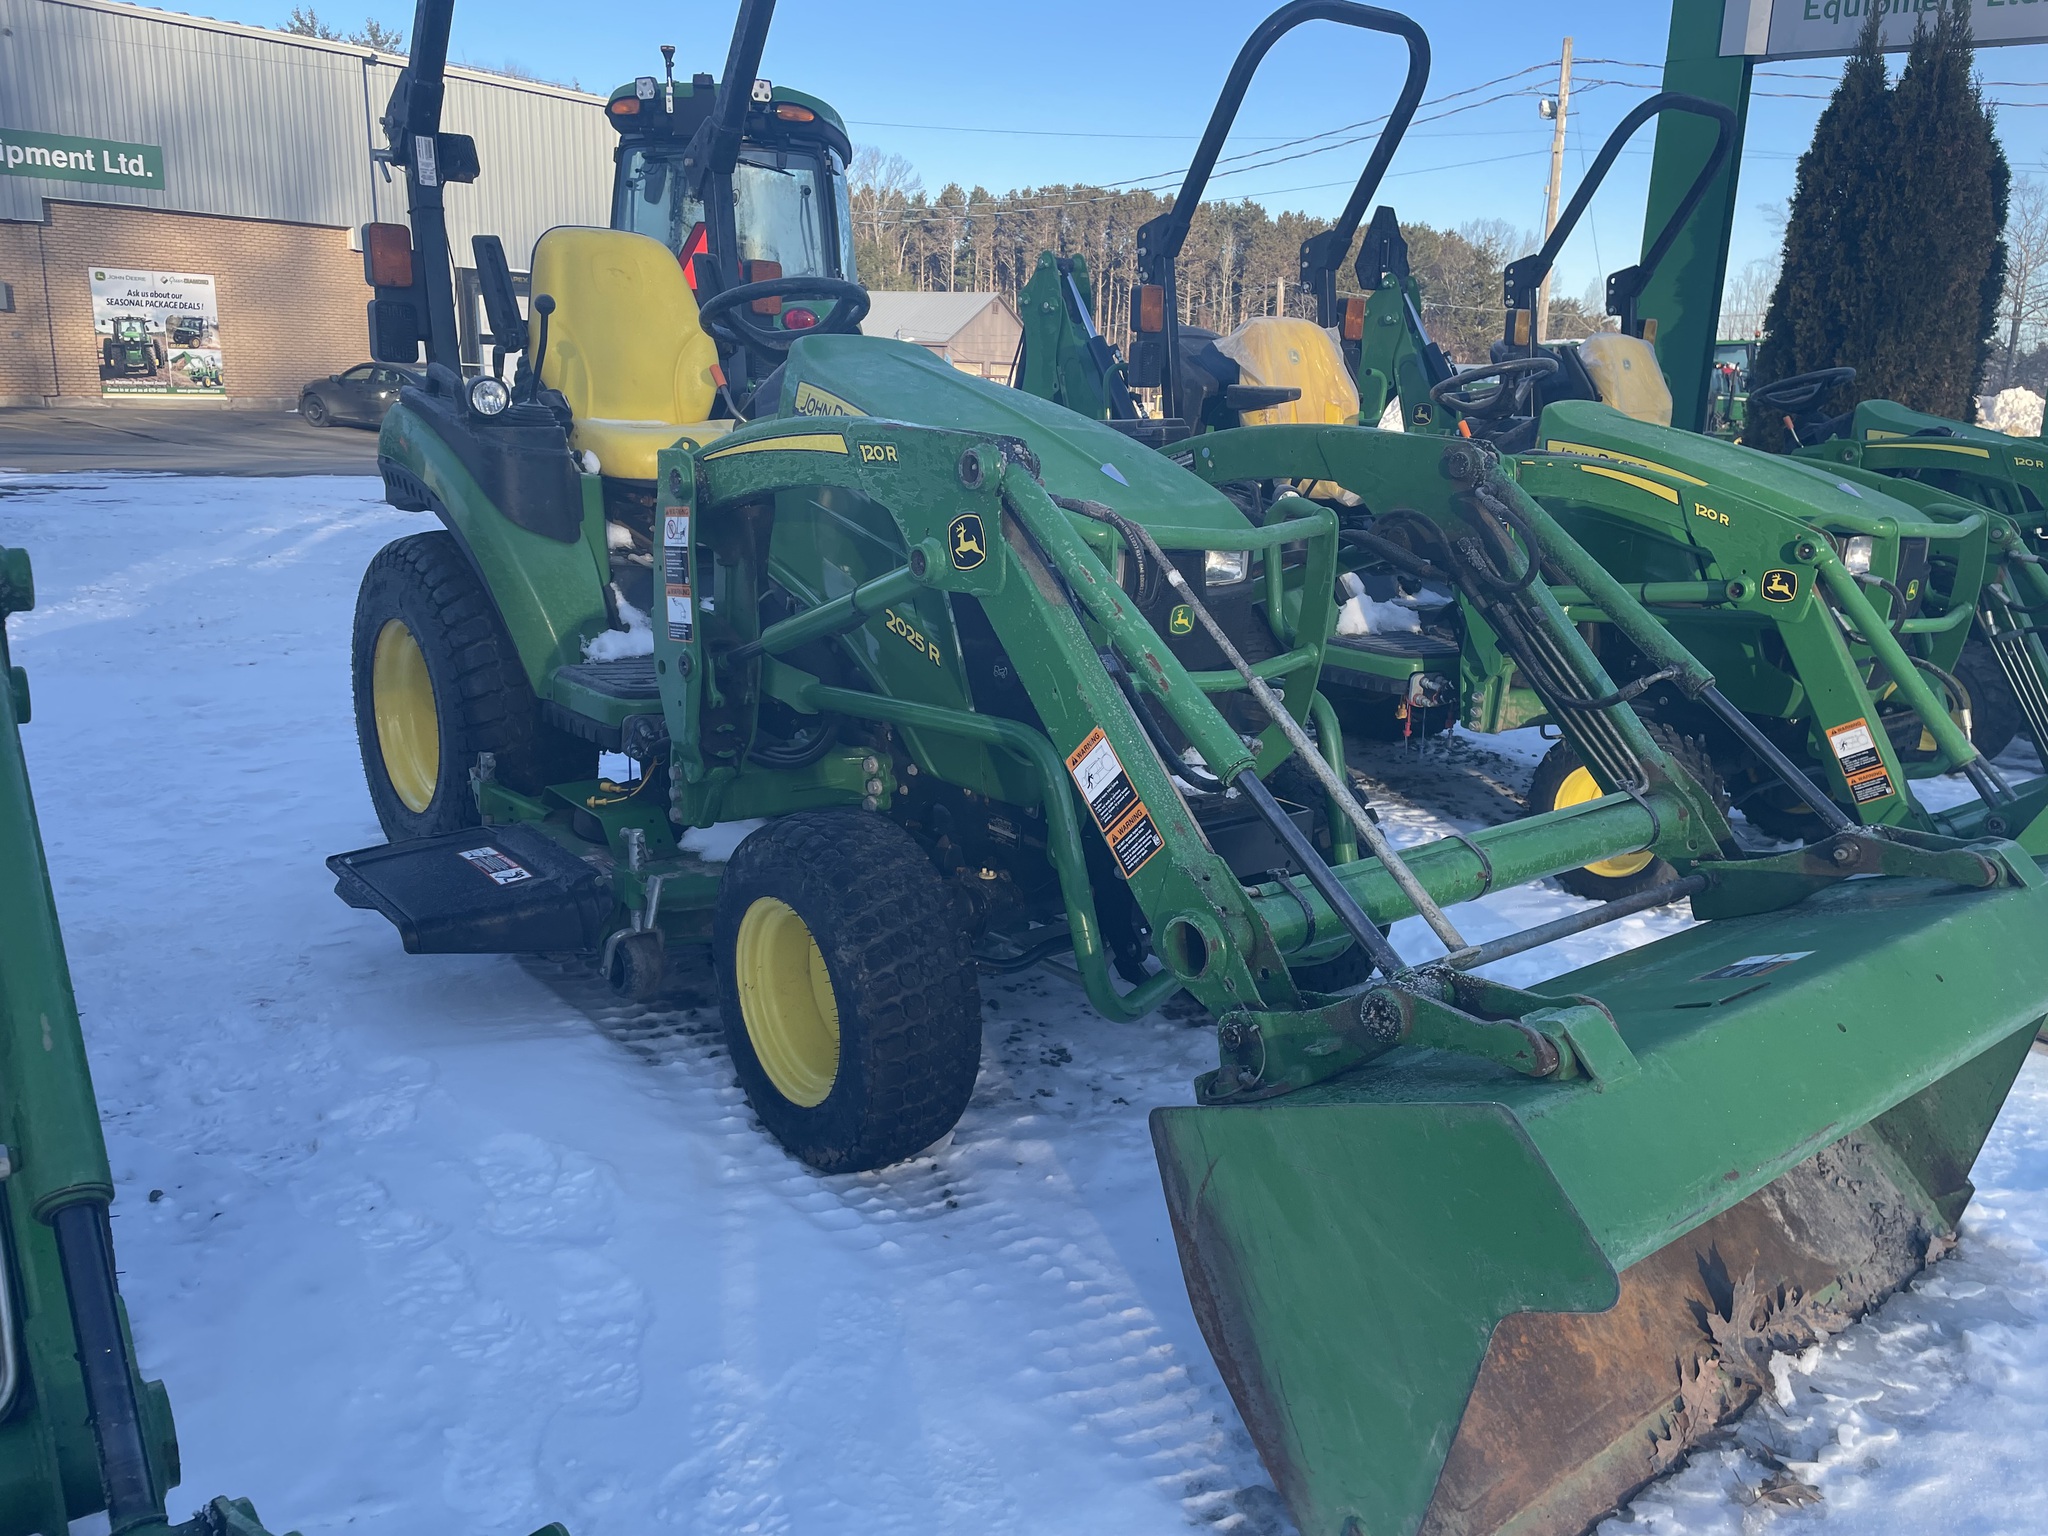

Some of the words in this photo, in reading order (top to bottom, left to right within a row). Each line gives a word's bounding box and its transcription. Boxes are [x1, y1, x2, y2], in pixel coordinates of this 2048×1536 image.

[103, 150, 153, 177] Ltd.
[106, 298, 144, 307] SEASONAL
[145, 299, 177, 309] PACKAGE
[179, 301, 200, 310] DEALS
[127, 289, 140, 297] Ask
[150, 290, 170, 298] about
[800, 393, 831, 416] JOHN
[859, 444, 884, 463] 120
[886, 445, 898, 462] R
[2013, 457, 2034, 467] 120
[2036, 460, 2044, 469] R
[1694, 502, 1718, 522] 120
[1719, 513, 1730, 526] R
[885, 608, 925, 652] 2025
[928, 641, 941, 667] R
[1076, 732, 1100, 760] WARNING
[1117, 809, 1143, 836] WARNING
